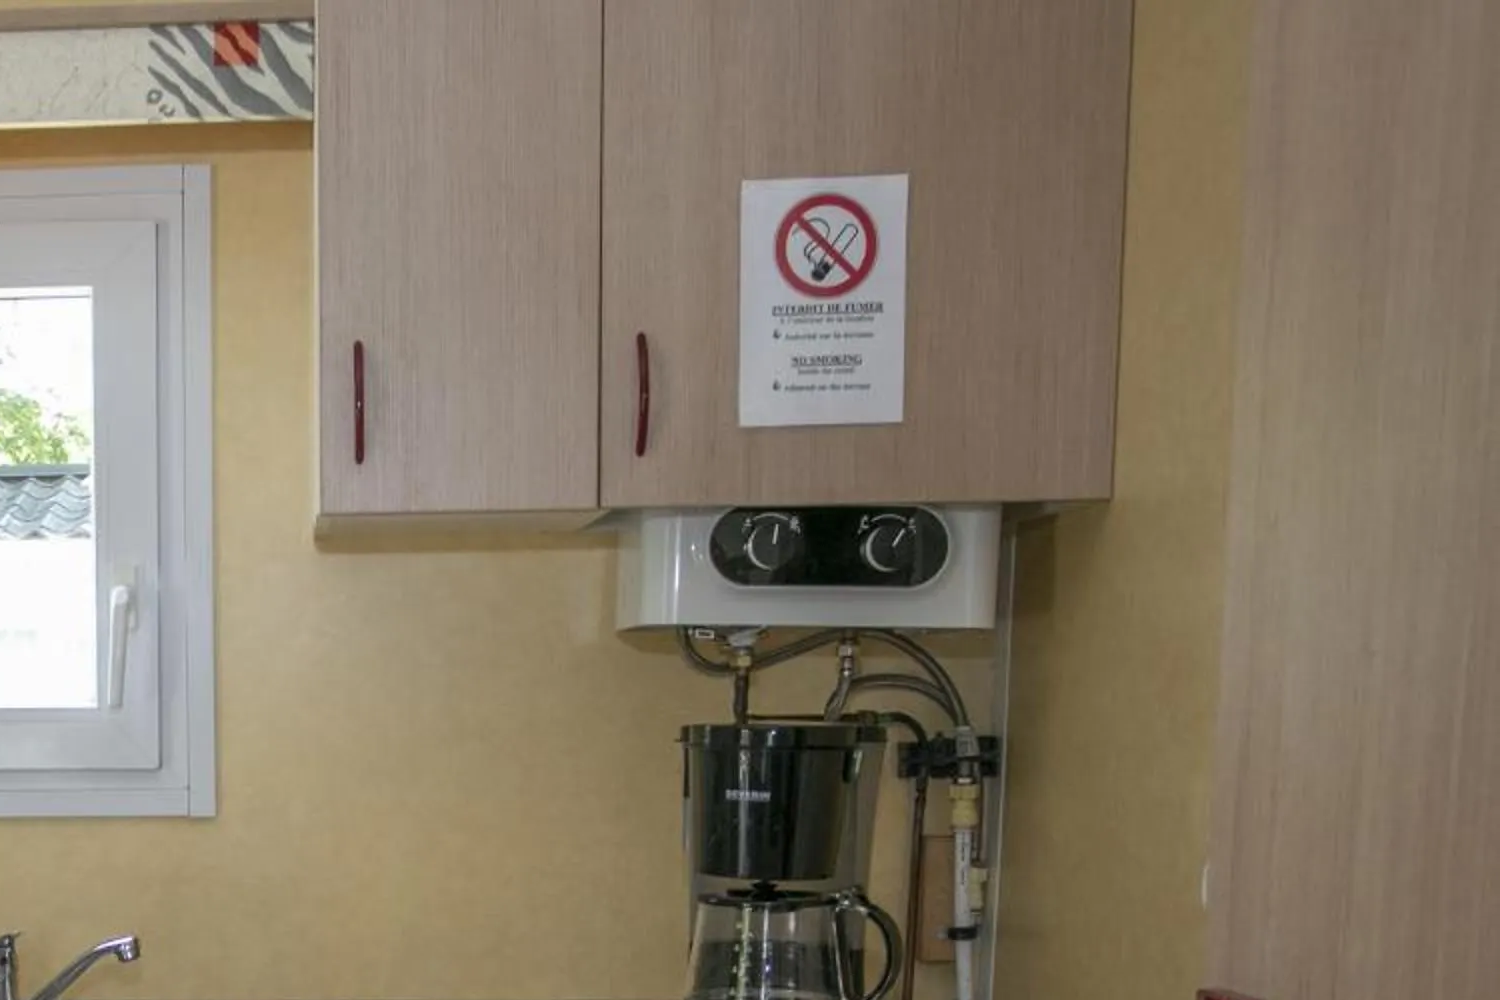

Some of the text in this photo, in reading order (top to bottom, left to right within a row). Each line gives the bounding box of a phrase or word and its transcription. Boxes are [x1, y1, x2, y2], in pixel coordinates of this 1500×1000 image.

[772, 302, 884, 316] INTERDIT DE FUMER
[791, 354, 863, 367] NO SMOKING
